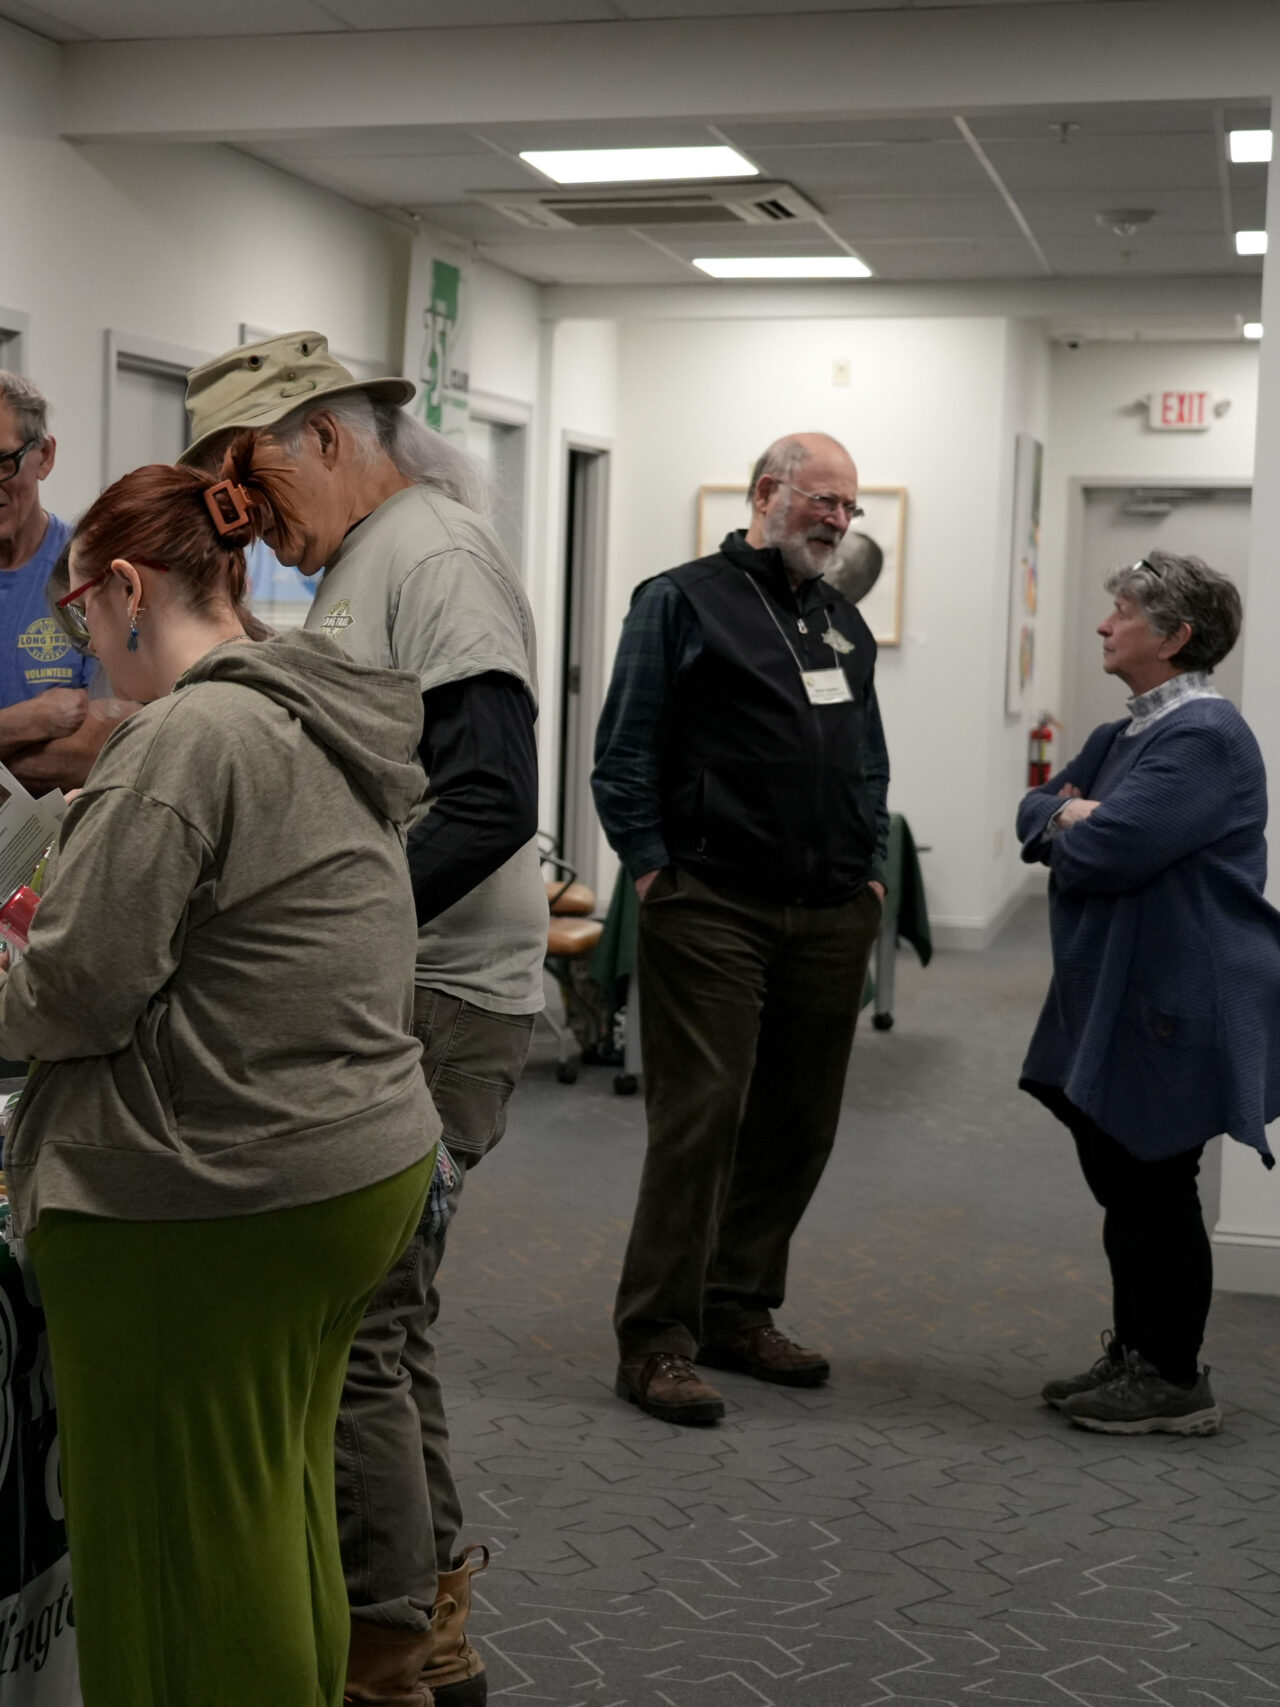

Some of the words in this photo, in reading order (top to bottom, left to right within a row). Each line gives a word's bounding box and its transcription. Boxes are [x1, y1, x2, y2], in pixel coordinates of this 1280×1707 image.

[1162, 392, 1207, 425] EXIT
[21, 636, 47, 645] LONG
[25, 667, 73, 680] VOLUNTEER
